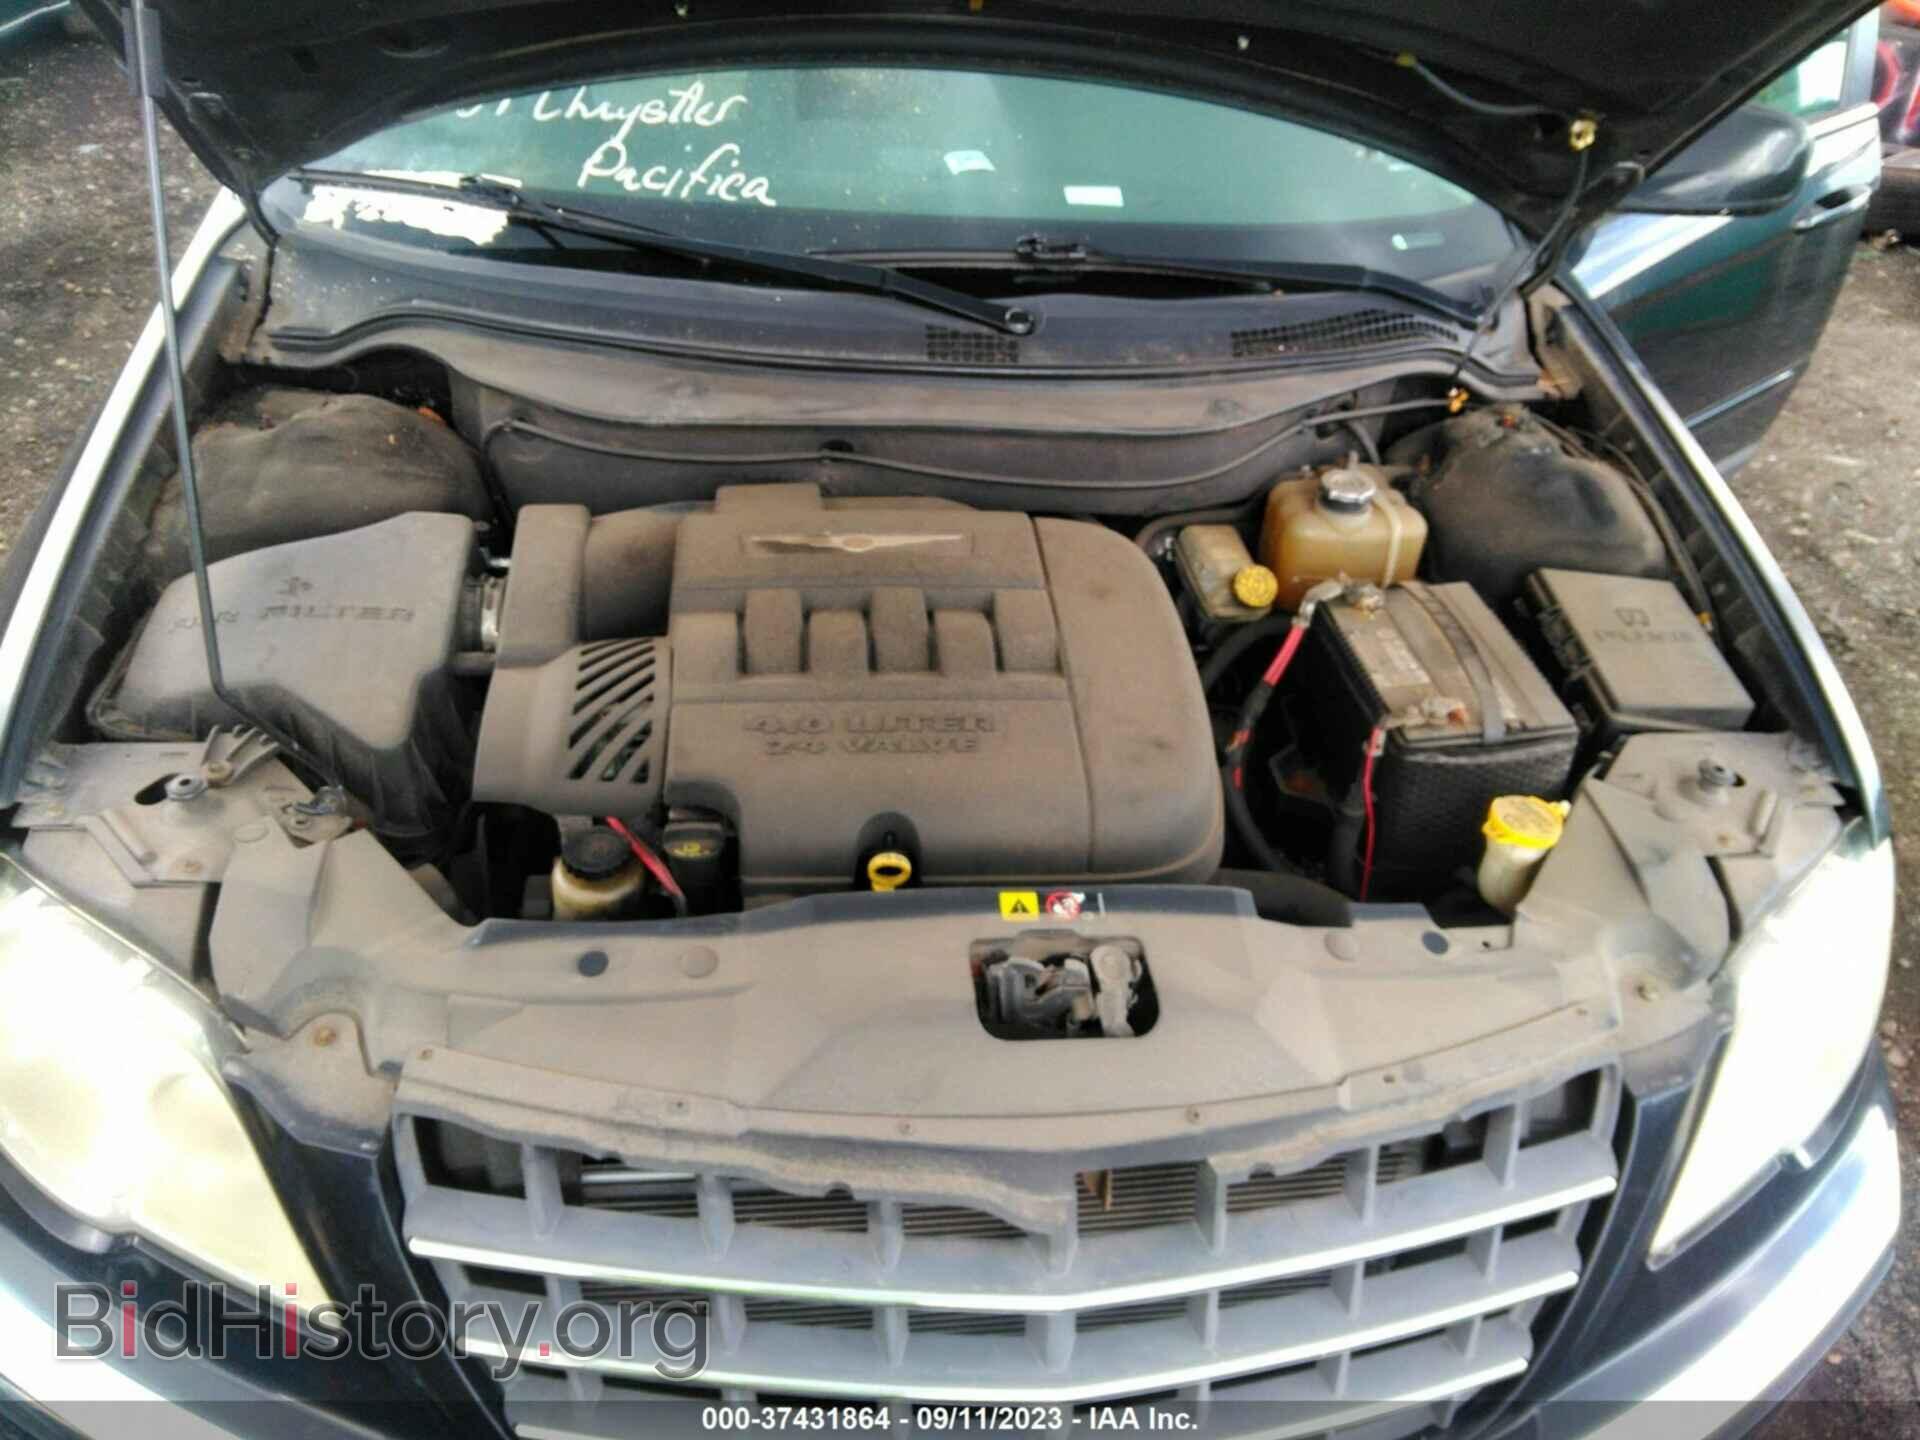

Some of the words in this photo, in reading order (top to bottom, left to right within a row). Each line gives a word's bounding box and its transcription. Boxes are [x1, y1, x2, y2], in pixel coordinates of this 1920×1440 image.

[577, 137, 777, 206] Pacifica
[168, 609, 239, 634] AR
[259, 603, 415, 624] FILTER
[846, 715, 995, 734] LITER
[838, 737, 978, 754] VALVE
